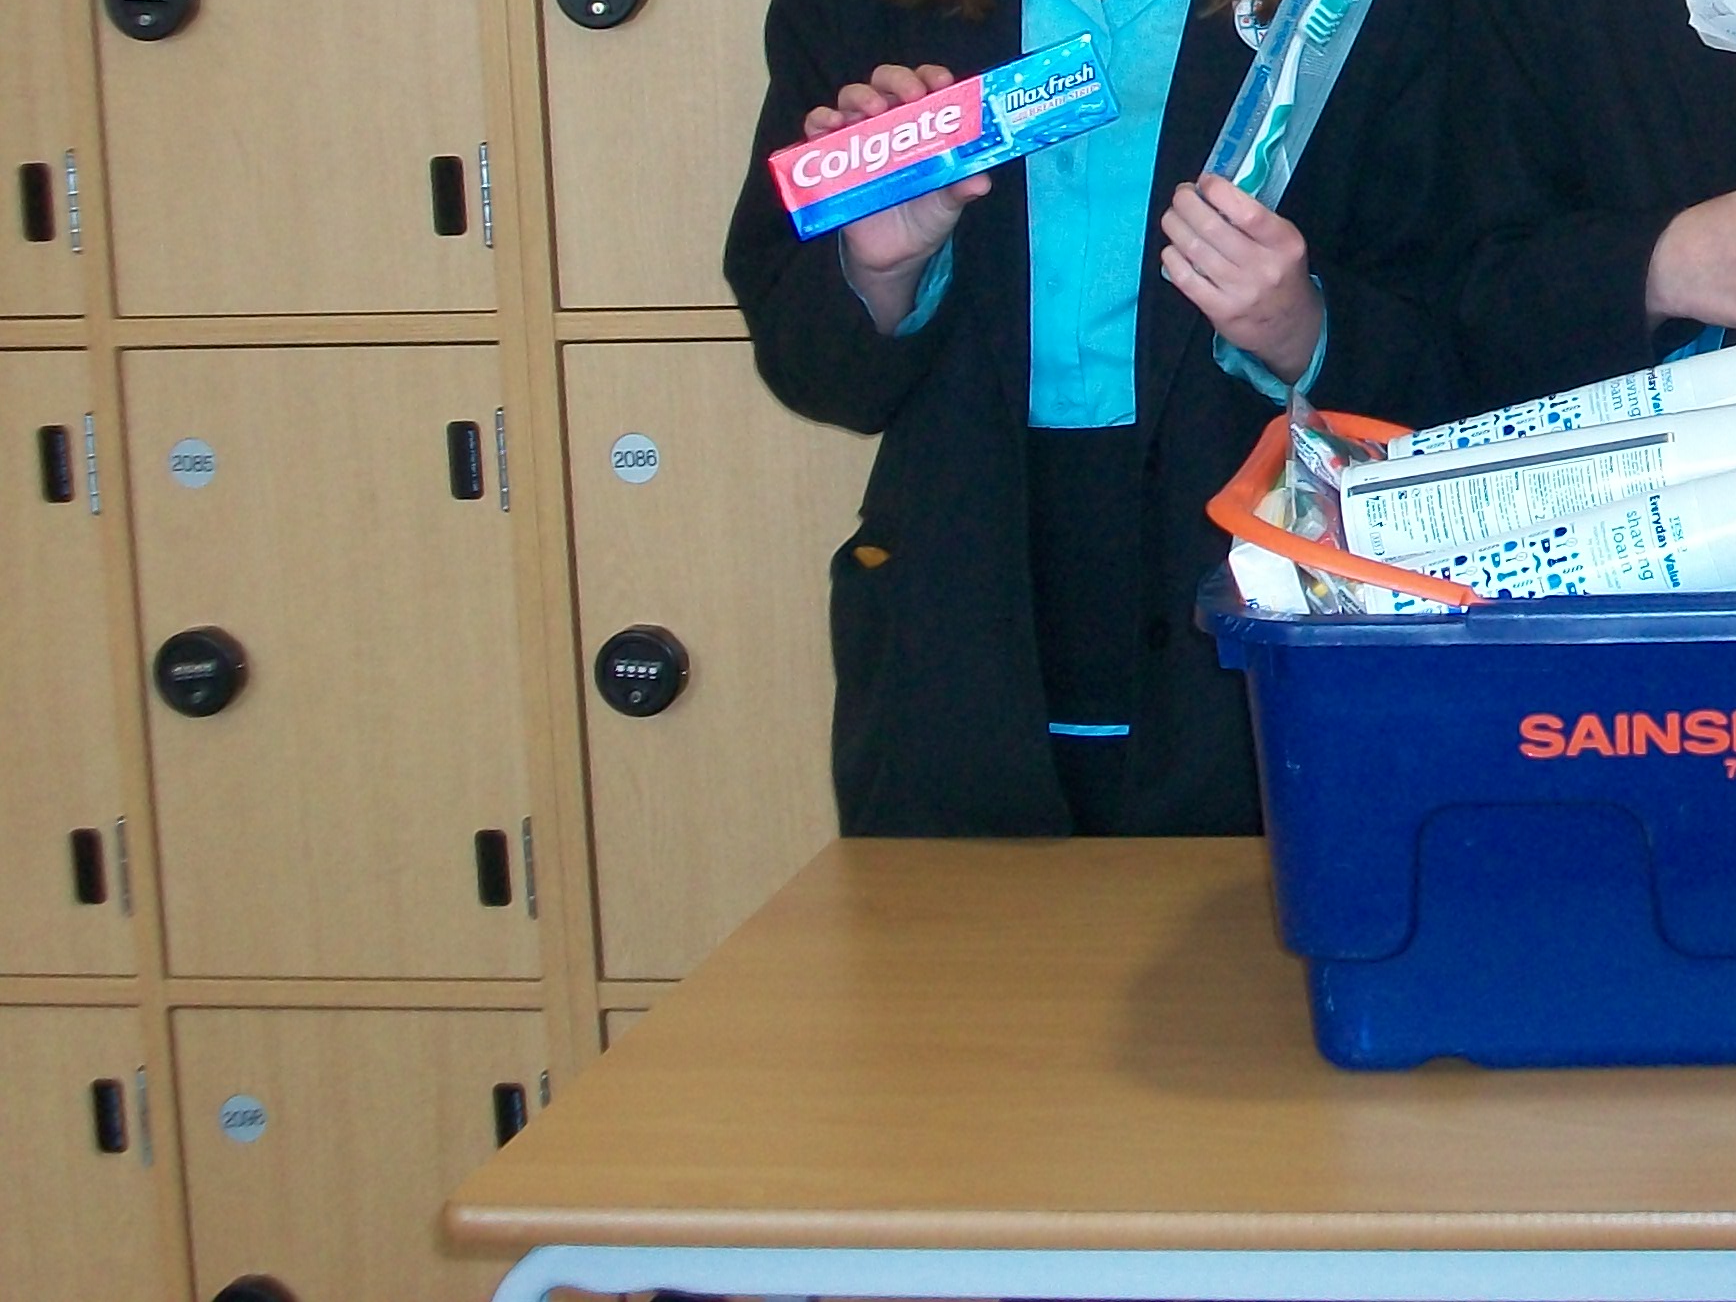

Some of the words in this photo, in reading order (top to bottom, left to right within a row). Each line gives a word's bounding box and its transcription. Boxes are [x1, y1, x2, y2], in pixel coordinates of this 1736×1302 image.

[791, 103, 963, 189] Colgate
[172, 454, 214, 472] 2085
[614, 450, 657, 468] 2086
[1611, 525, 1633, 574] foam
[1626, 509, 1655, 581] shaving
[1649, 494, 1668, 549] Everyday
[1663, 552, 1681, 589] Value
